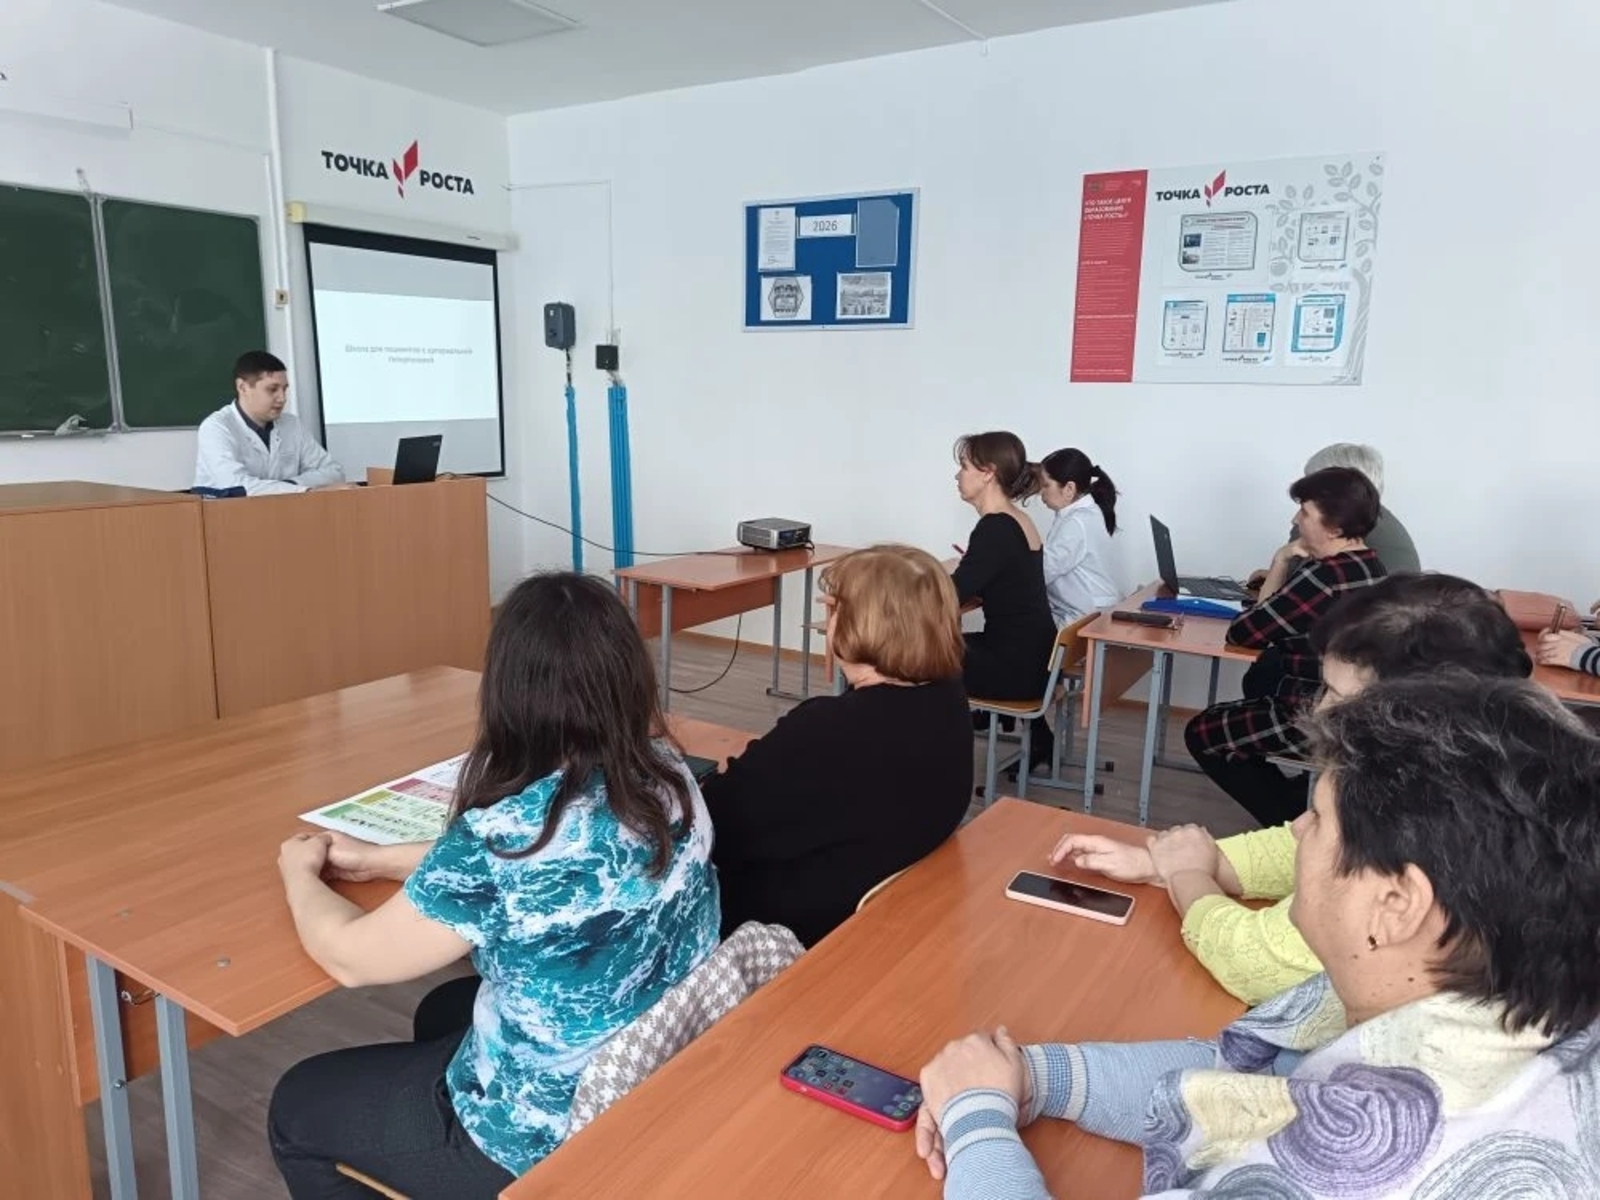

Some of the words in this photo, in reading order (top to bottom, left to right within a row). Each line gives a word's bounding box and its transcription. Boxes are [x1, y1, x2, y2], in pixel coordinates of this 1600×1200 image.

[321, 150, 389, 180] ТОЧКА
[419, 169, 474, 195] РОСТА
[1156, 188, 1201, 201] ТОЧКА
[1224, 184, 1270, 197] РОСТА
[812, 220, 838, 232] 2026
